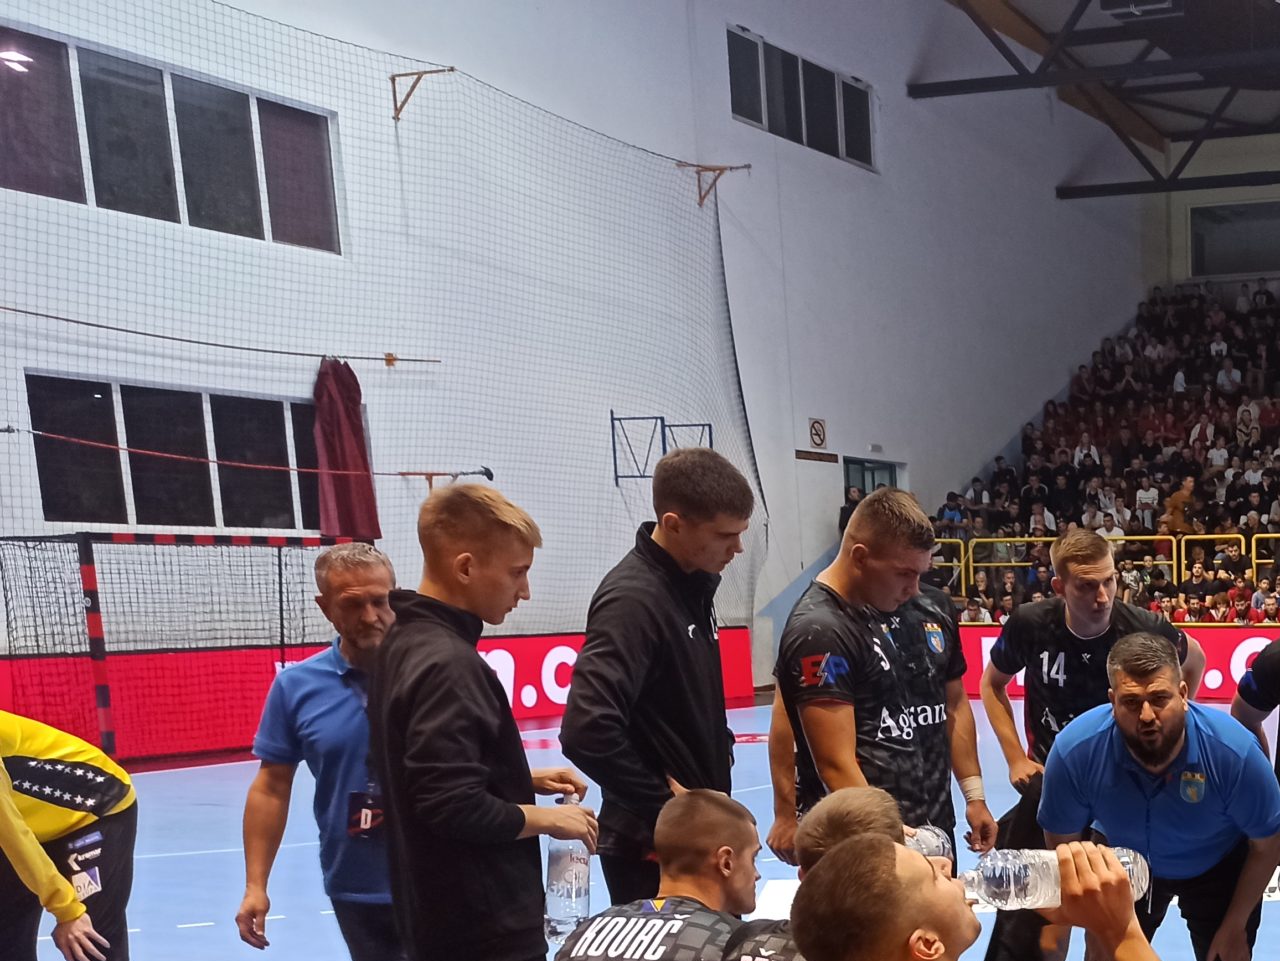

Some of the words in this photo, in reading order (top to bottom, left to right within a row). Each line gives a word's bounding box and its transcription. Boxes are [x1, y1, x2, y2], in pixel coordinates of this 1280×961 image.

[1039, 650, 1067, 687] 14
[360, 808, 372, 829] D
[570, 913, 691, 961] KOVAČ
